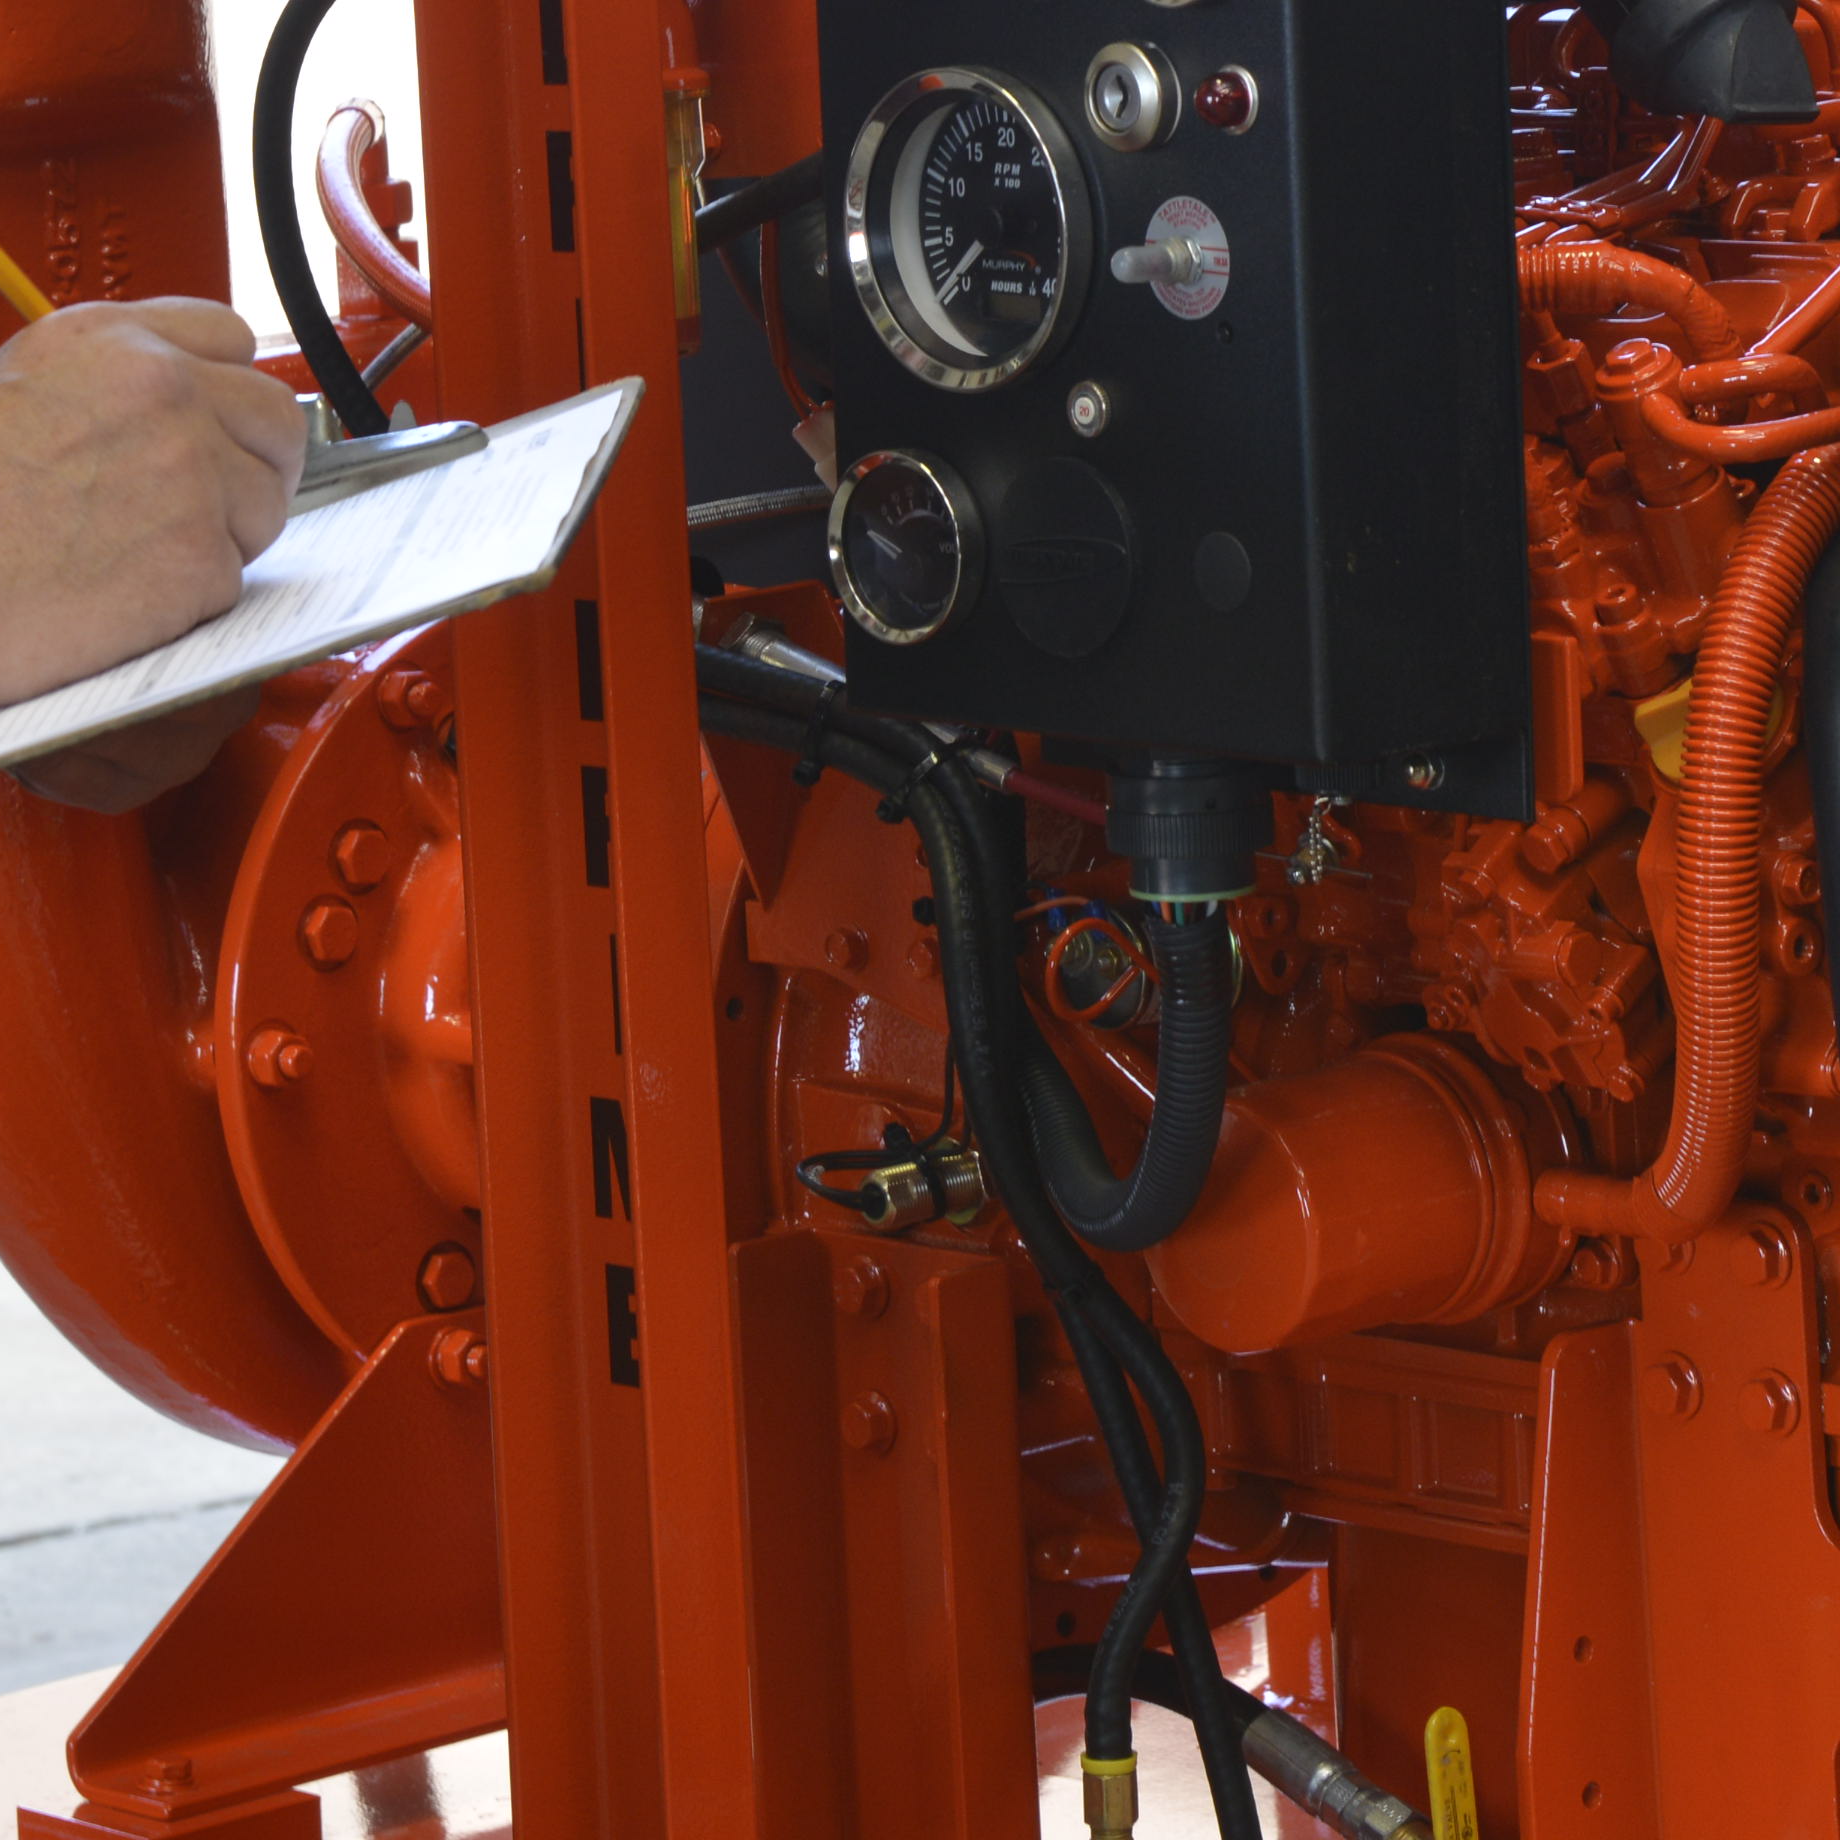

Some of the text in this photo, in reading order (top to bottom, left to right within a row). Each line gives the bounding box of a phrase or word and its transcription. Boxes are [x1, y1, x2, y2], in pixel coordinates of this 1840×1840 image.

[997, 127, 1015, 148] 20
[966, 141, 983, 162] 15
[994, 162, 1021, 176] RPM
[948, 177, 966, 198] 10
[1004, 178, 1021, 189] 100
[945, 226, 954, 247] 5
[982, 258, 1026, 272] MURPHY
[991, 280, 1023, 294] HOURS
[1079, 406, 1090, 417] 20
